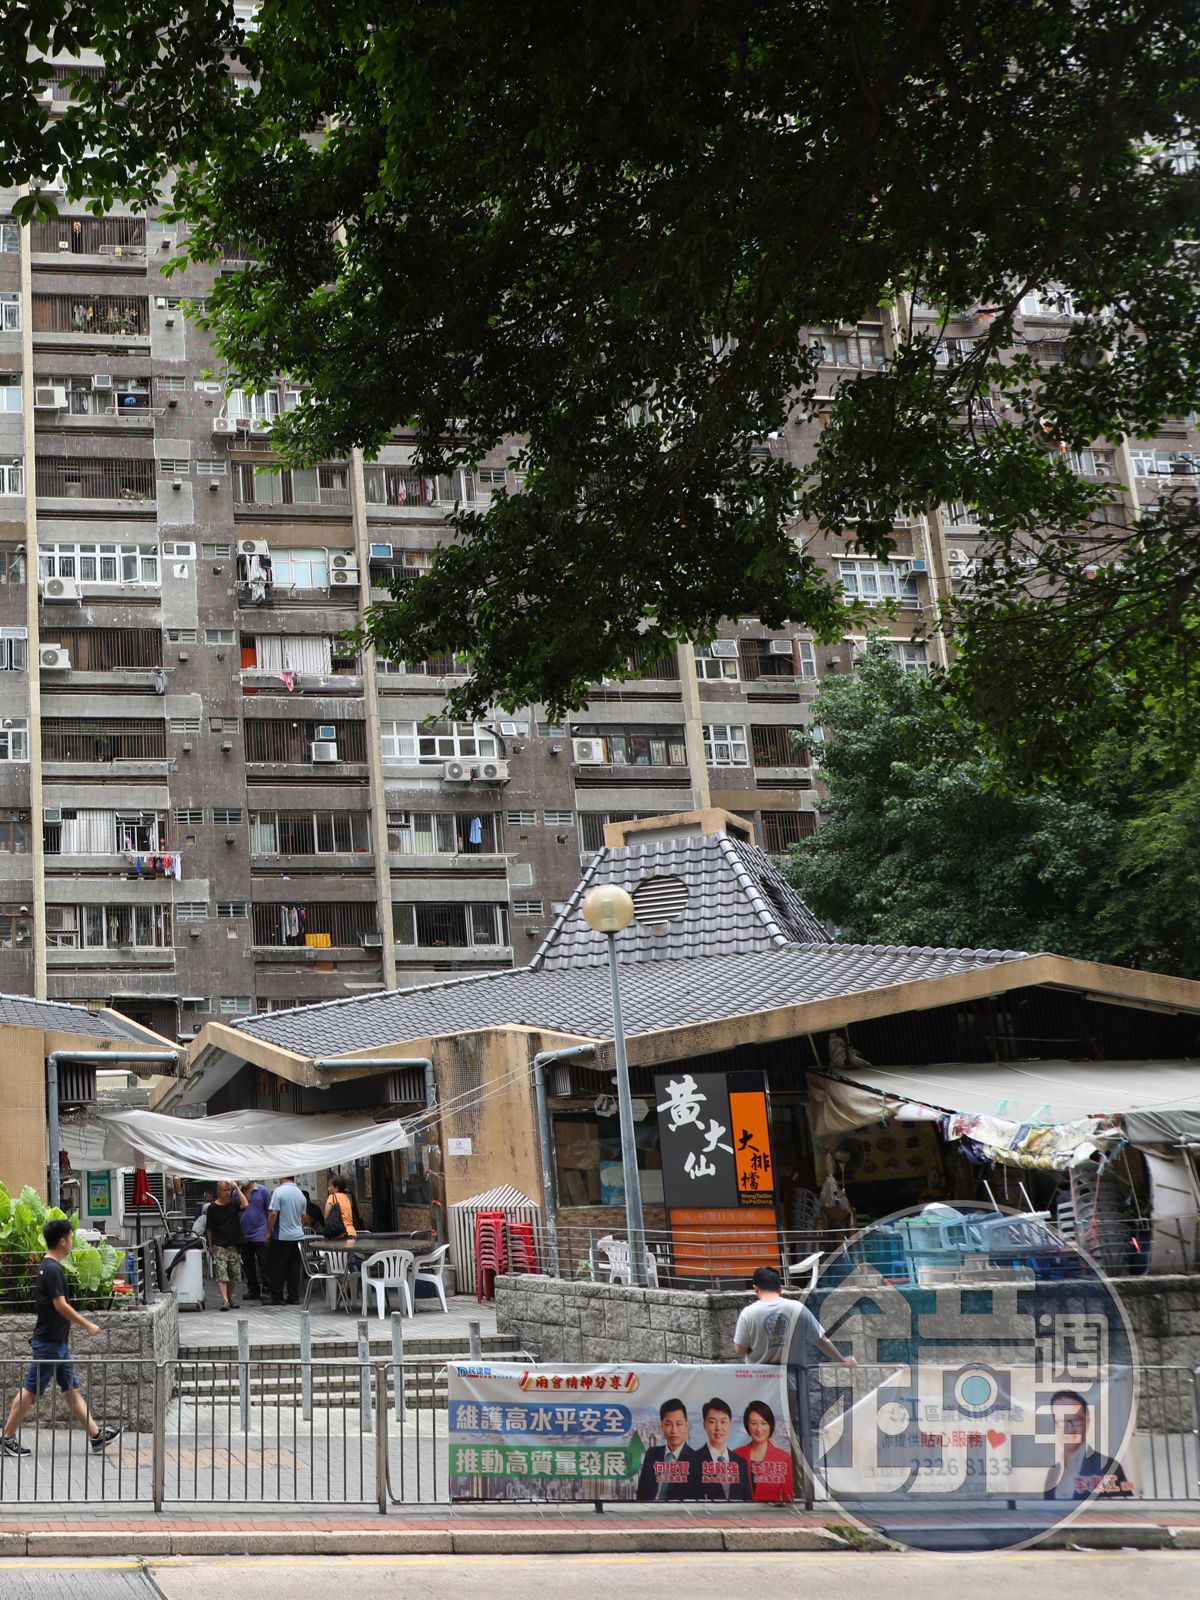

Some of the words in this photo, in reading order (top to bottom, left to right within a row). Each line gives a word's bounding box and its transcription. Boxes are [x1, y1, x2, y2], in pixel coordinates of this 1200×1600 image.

[656, 1074, 734, 1180] 黃大仙
[737, 1129, 771, 1190] 大排檔
[535, 1375, 622, 1390] 兩會精神分享
[456, 1404, 625, 1433] 維護高水平安全
[456, 1448, 627, 1476] 推動高質量發展
[910, 1458, 960, 1477] 2326
[965, 1458, 1013, 1477] 8133
